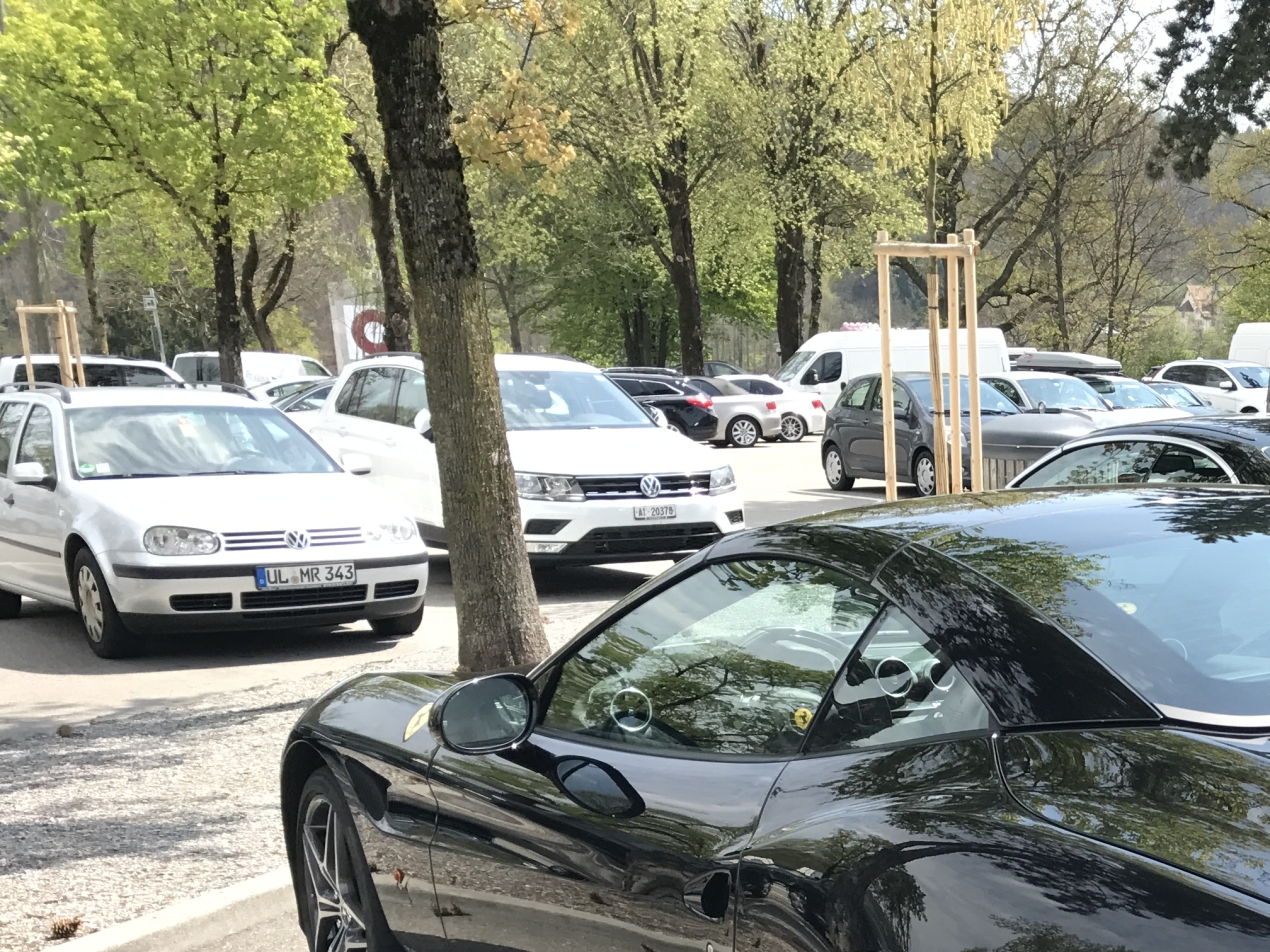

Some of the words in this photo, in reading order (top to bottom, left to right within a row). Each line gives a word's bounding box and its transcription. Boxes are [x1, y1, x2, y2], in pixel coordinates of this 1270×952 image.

[266, 568, 289, 585] UL
[300, 566, 322, 583] MR
[324, 564, 354, 581] 343
